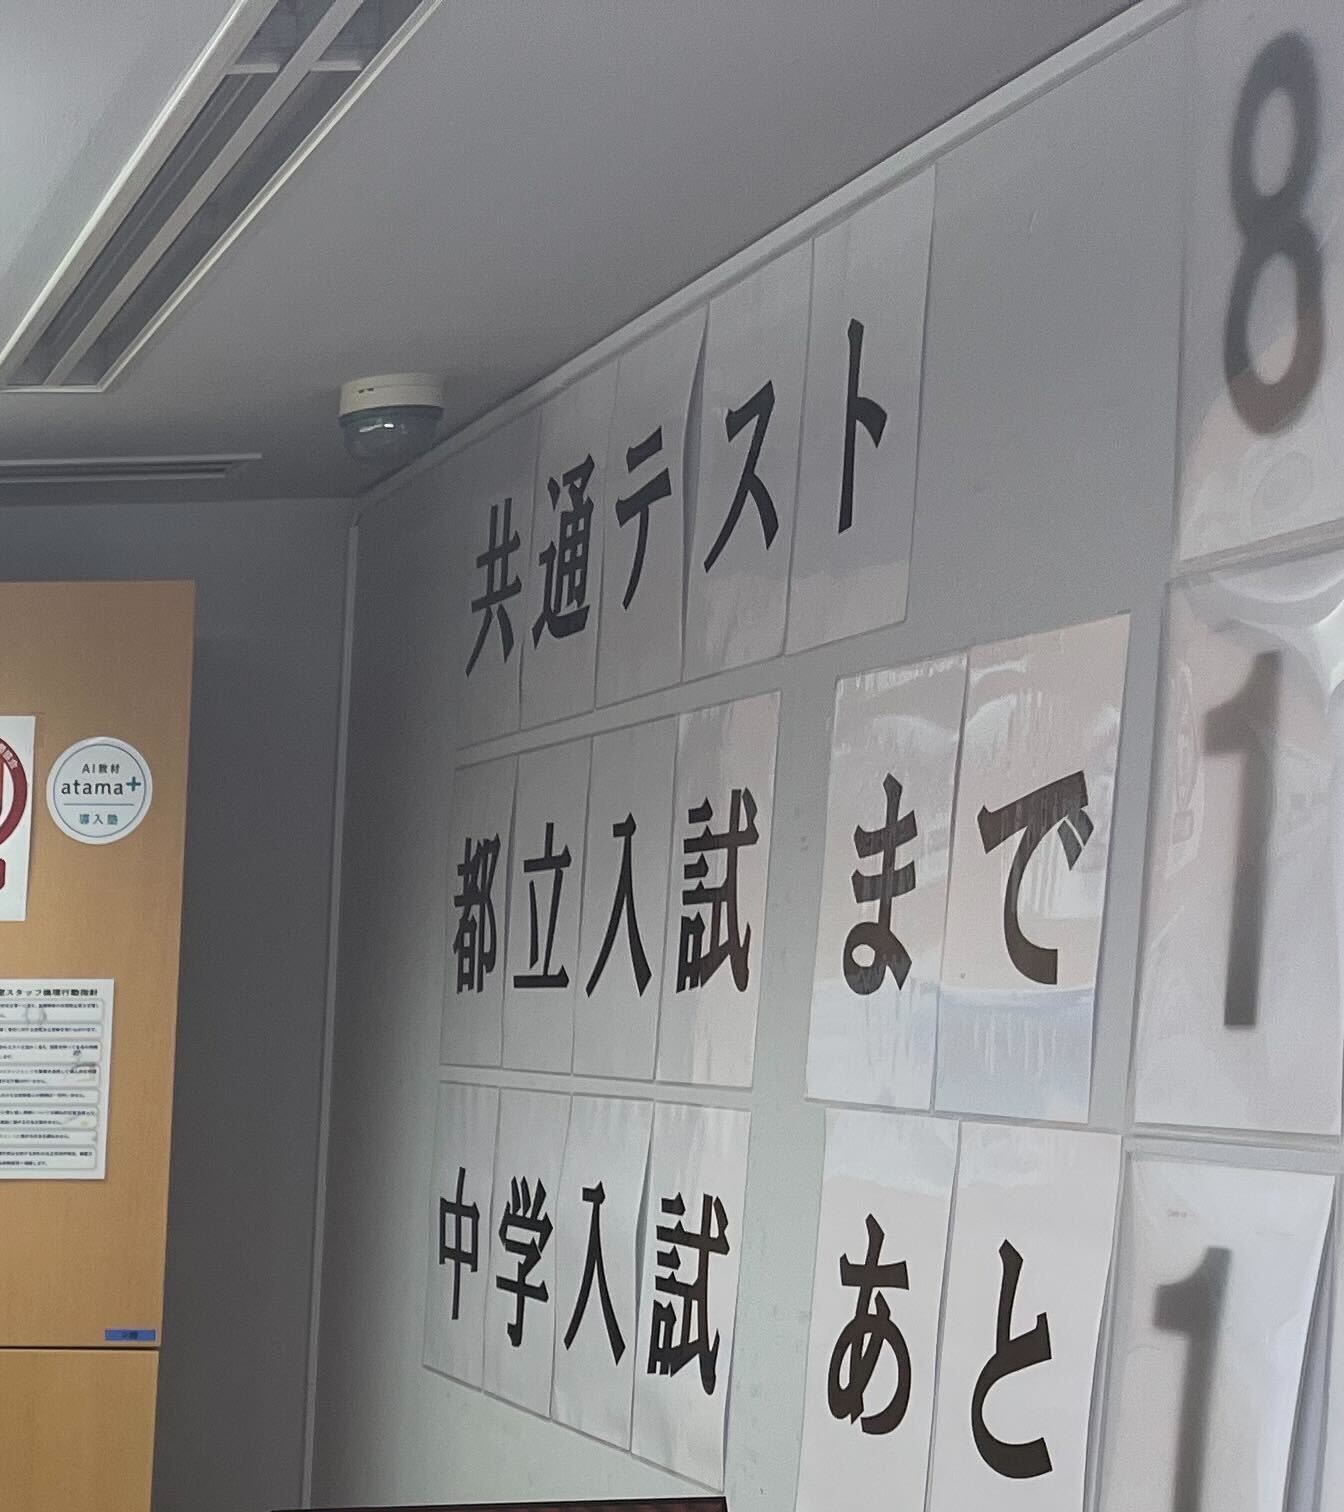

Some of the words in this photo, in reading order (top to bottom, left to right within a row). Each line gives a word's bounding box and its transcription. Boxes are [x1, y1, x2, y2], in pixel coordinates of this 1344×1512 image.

[1224, 30, 1325, 437] 8
[466, 317, 888, 677] 共通テスト
[79, 814, 118, 825] 導入塾
[82, 764, 120, 774] AI教材
[843, 770, 1094, 995] まで
[1204, 650, 1282, 1028] 1
[453, 788, 760, 995] 都立入試
[438, 1168, 731, 1395] 中学入試
[827, 1212, 1053, 1480] あと
